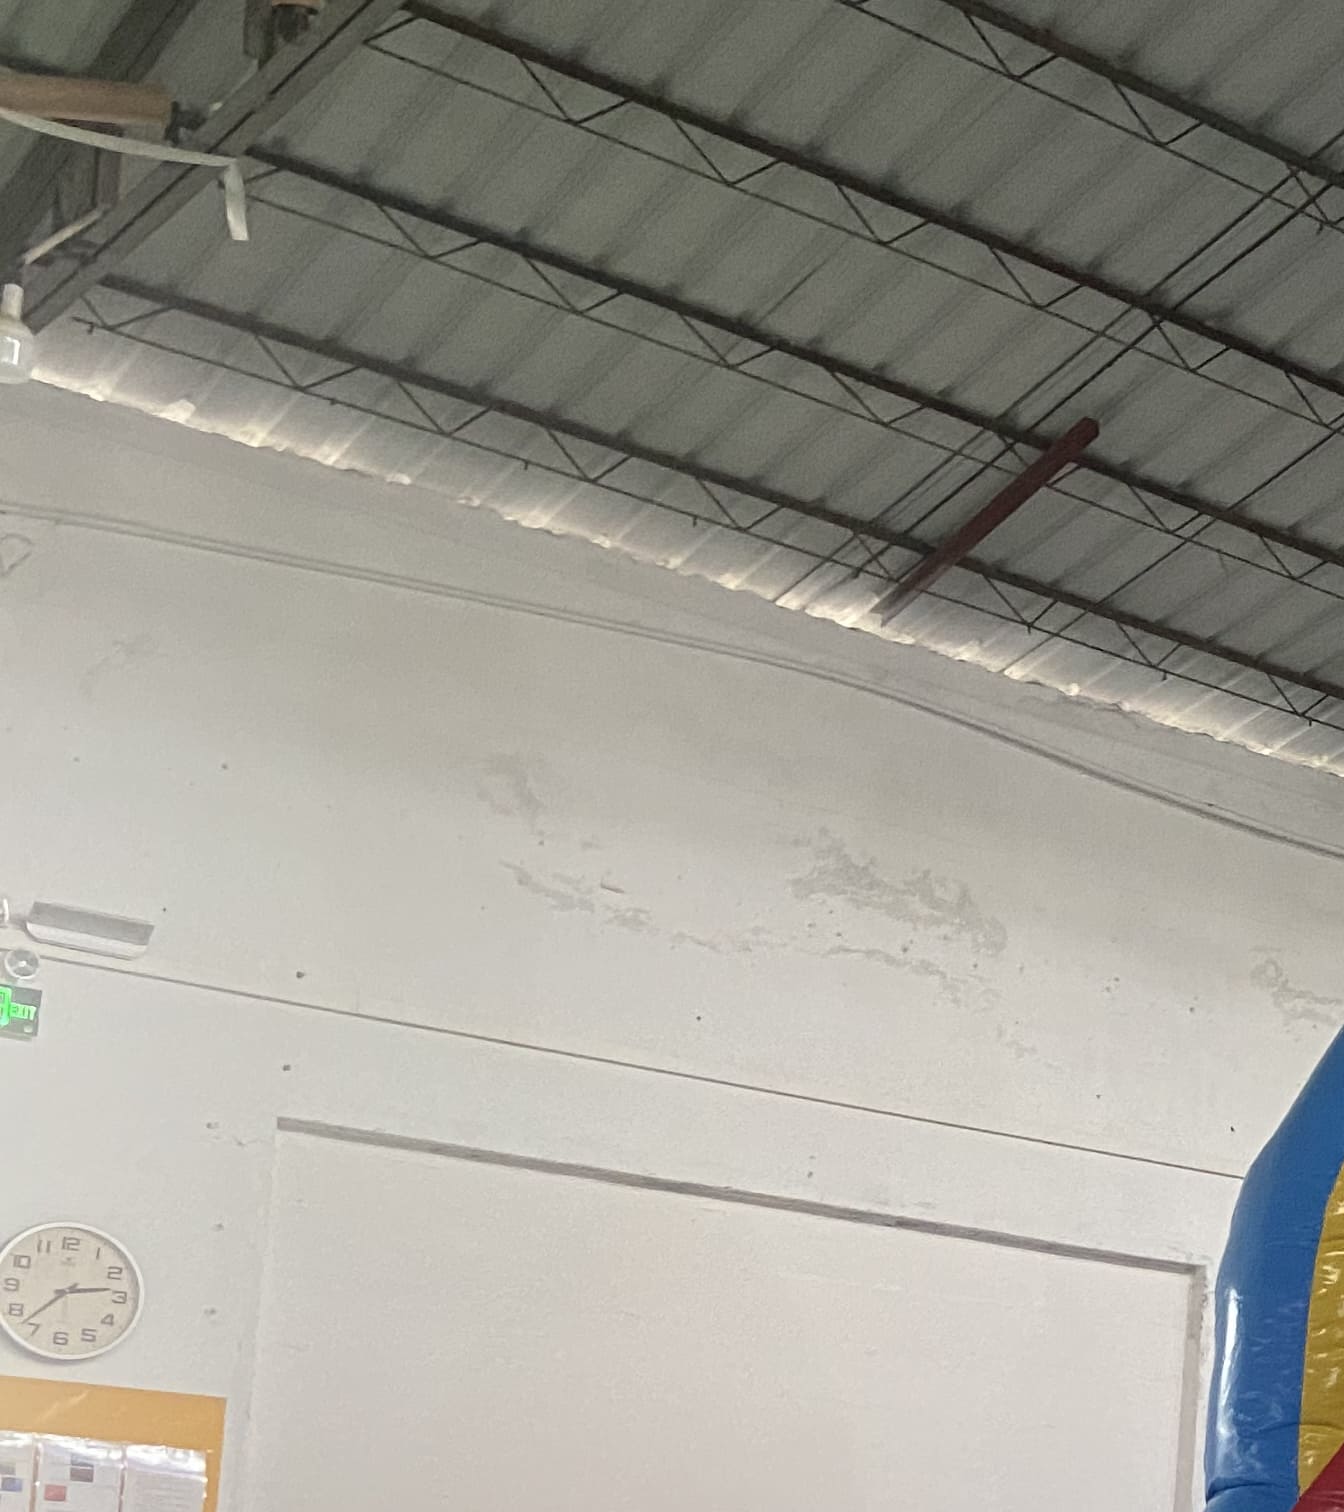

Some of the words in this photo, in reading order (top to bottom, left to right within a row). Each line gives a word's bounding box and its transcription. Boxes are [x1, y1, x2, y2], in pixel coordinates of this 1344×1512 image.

[37, 1239, 51, 1253] 11
[62, 1236, 80, 1251] 12
[95, 1247, 101, 1260] 1
[13, 1255, 31, 1269] 10
[107, 1266, 123, 1280] 2
[3, 1277, 20, 1291] 9
[111, 1290, 127, 1304] 3
[8, 1303, 24, 1317] 8
[100, 1313, 115, 1326] 4
[28, 1322, 41, 1336] 7
[81, 1328, 97, 1342] 5
[52, 1331, 69, 1345] 6
